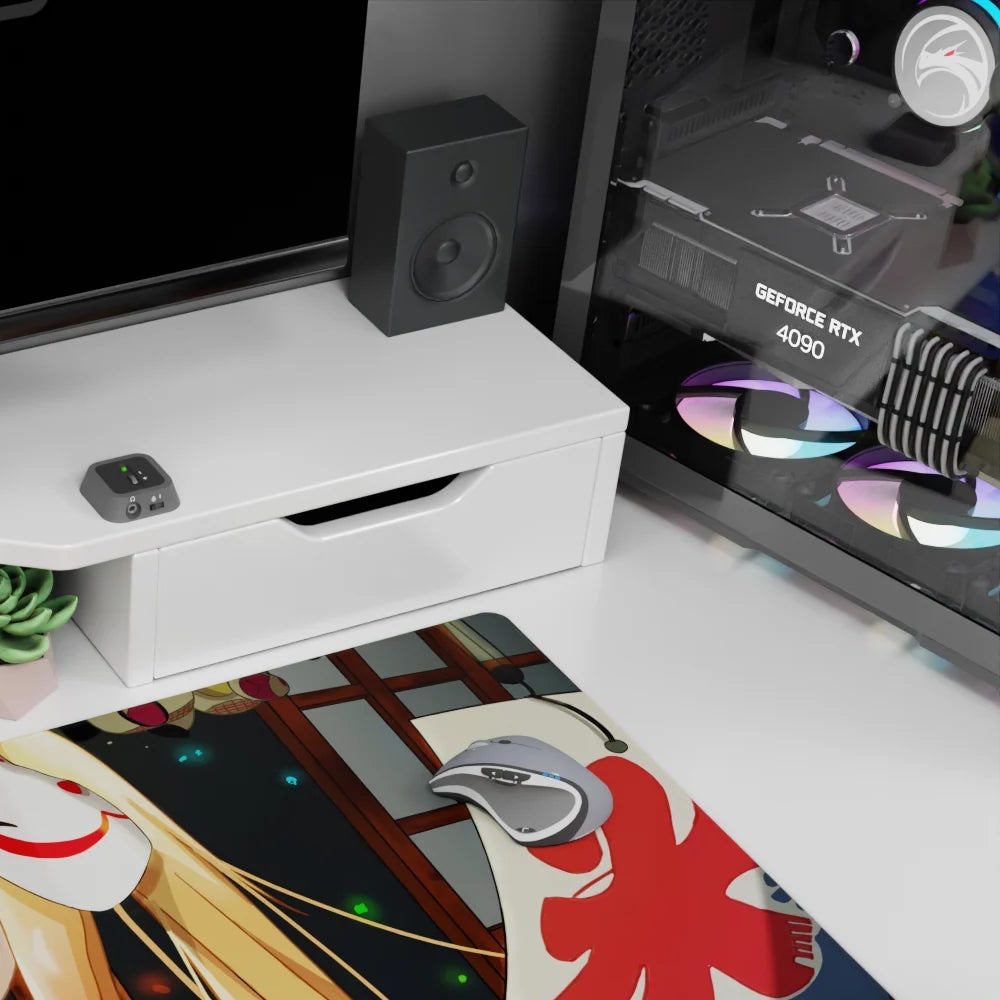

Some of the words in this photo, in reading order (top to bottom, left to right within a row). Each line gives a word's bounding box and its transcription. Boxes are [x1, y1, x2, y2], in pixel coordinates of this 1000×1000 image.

[755, 282, 827, 329] GEFORCE
[828, 318, 863, 347] RTX
[776, 325, 825, 359] 4090
